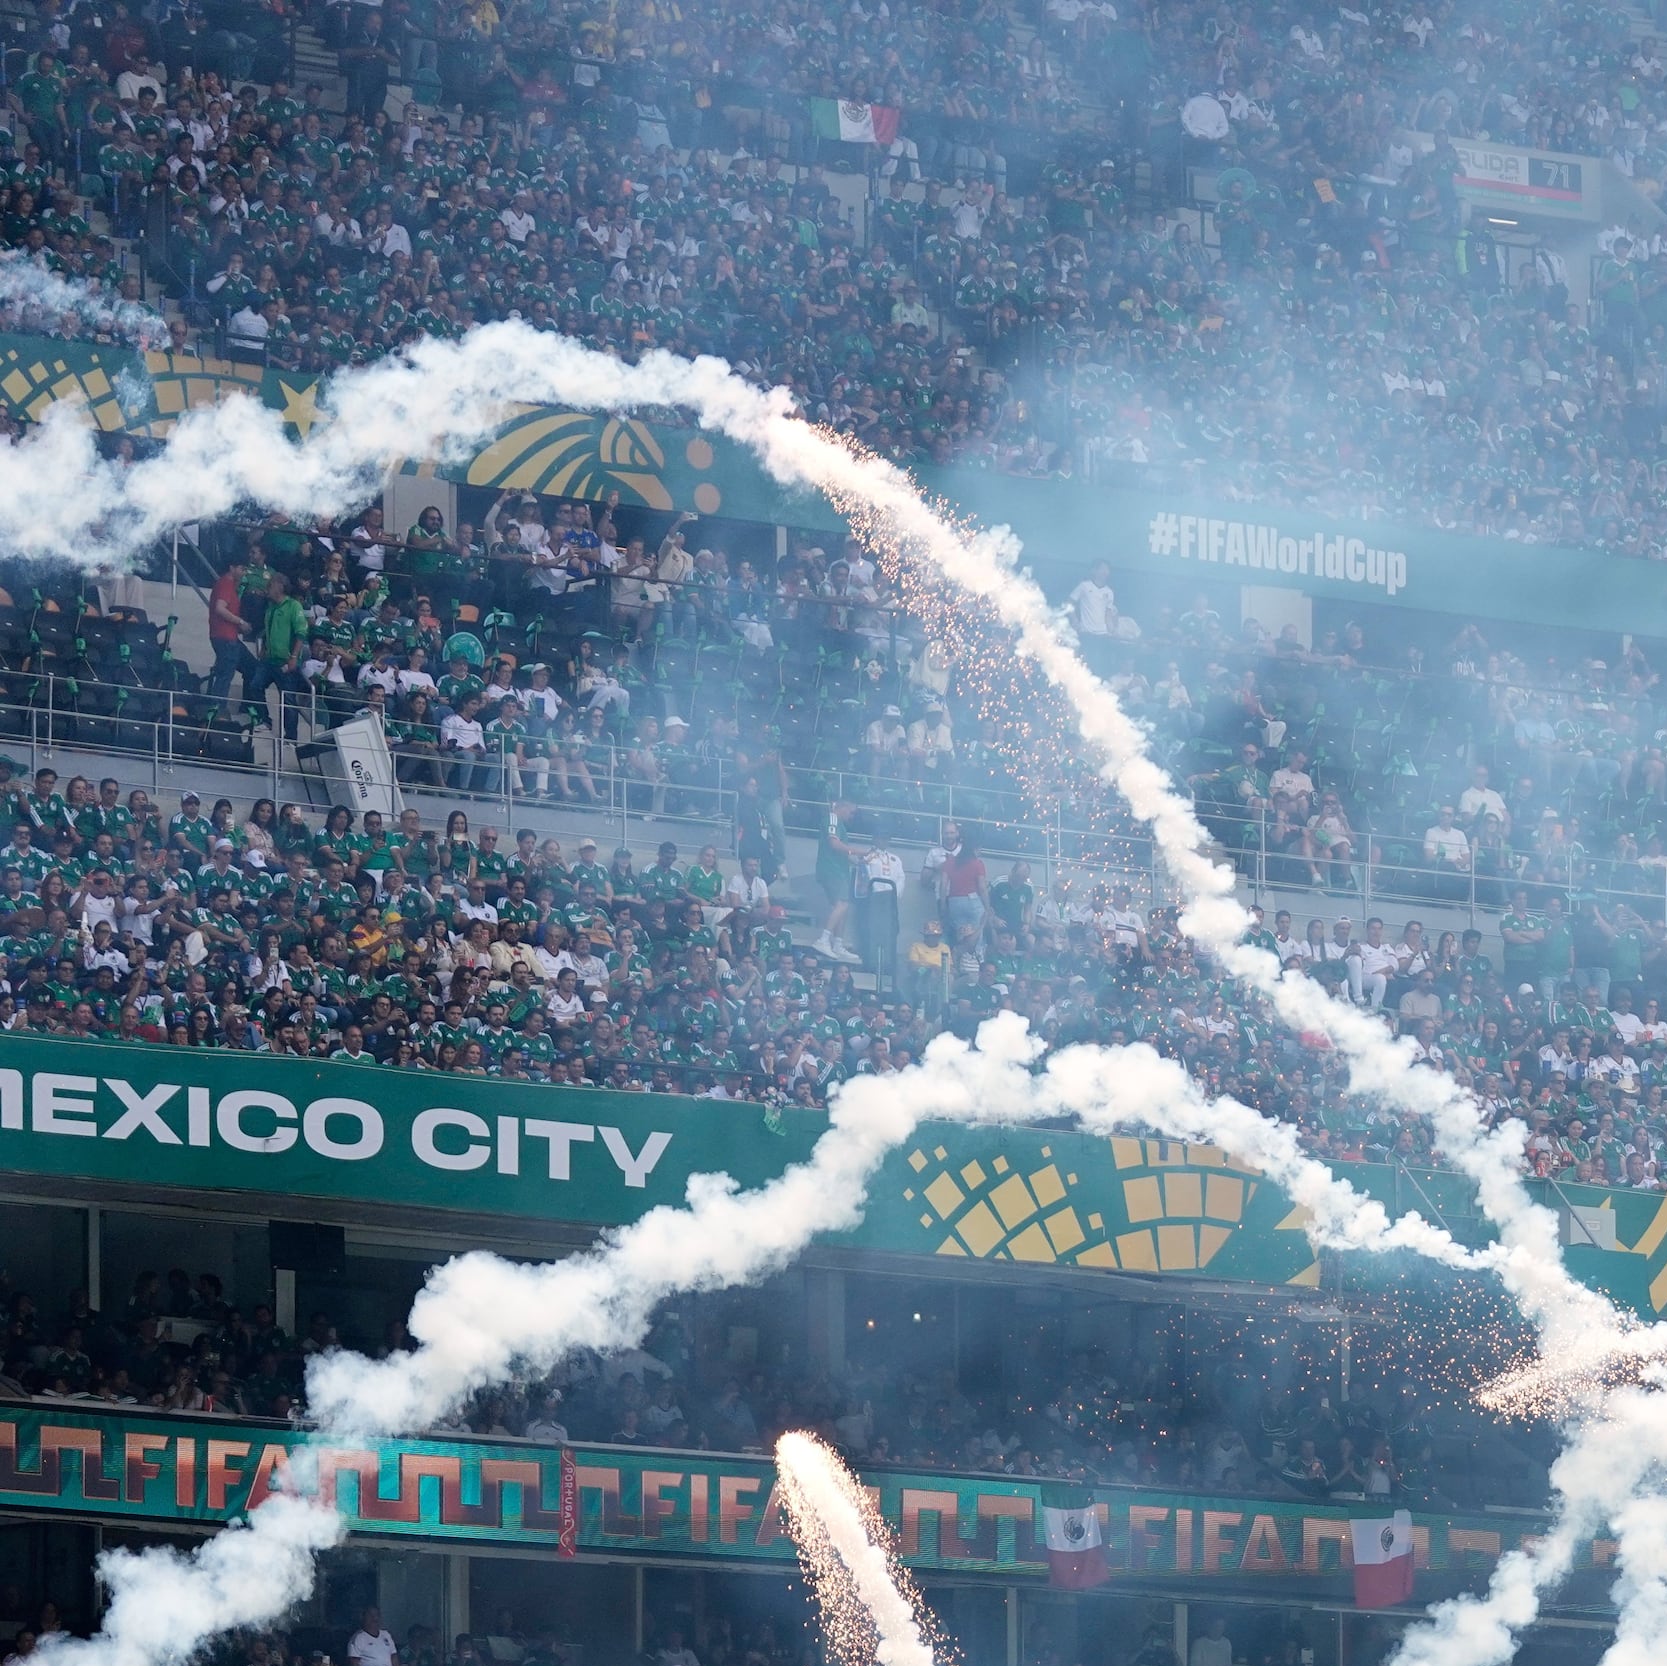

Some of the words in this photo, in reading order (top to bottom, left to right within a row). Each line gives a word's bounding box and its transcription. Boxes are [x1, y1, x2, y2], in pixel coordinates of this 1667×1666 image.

[1458, 149, 1520, 173] ALIDA
[1541, 160, 1570, 189] 71
[1149, 512, 1407, 595] #FIFAWorldCup
[351, 760, 369, 799] Corona
[412, 1107, 673, 1189] CITY
[126, 1432, 294, 1511] FIFA
[562, 1467, 575, 1527] PORTUGAL
[1130, 1505, 1288, 1572] FIFA
